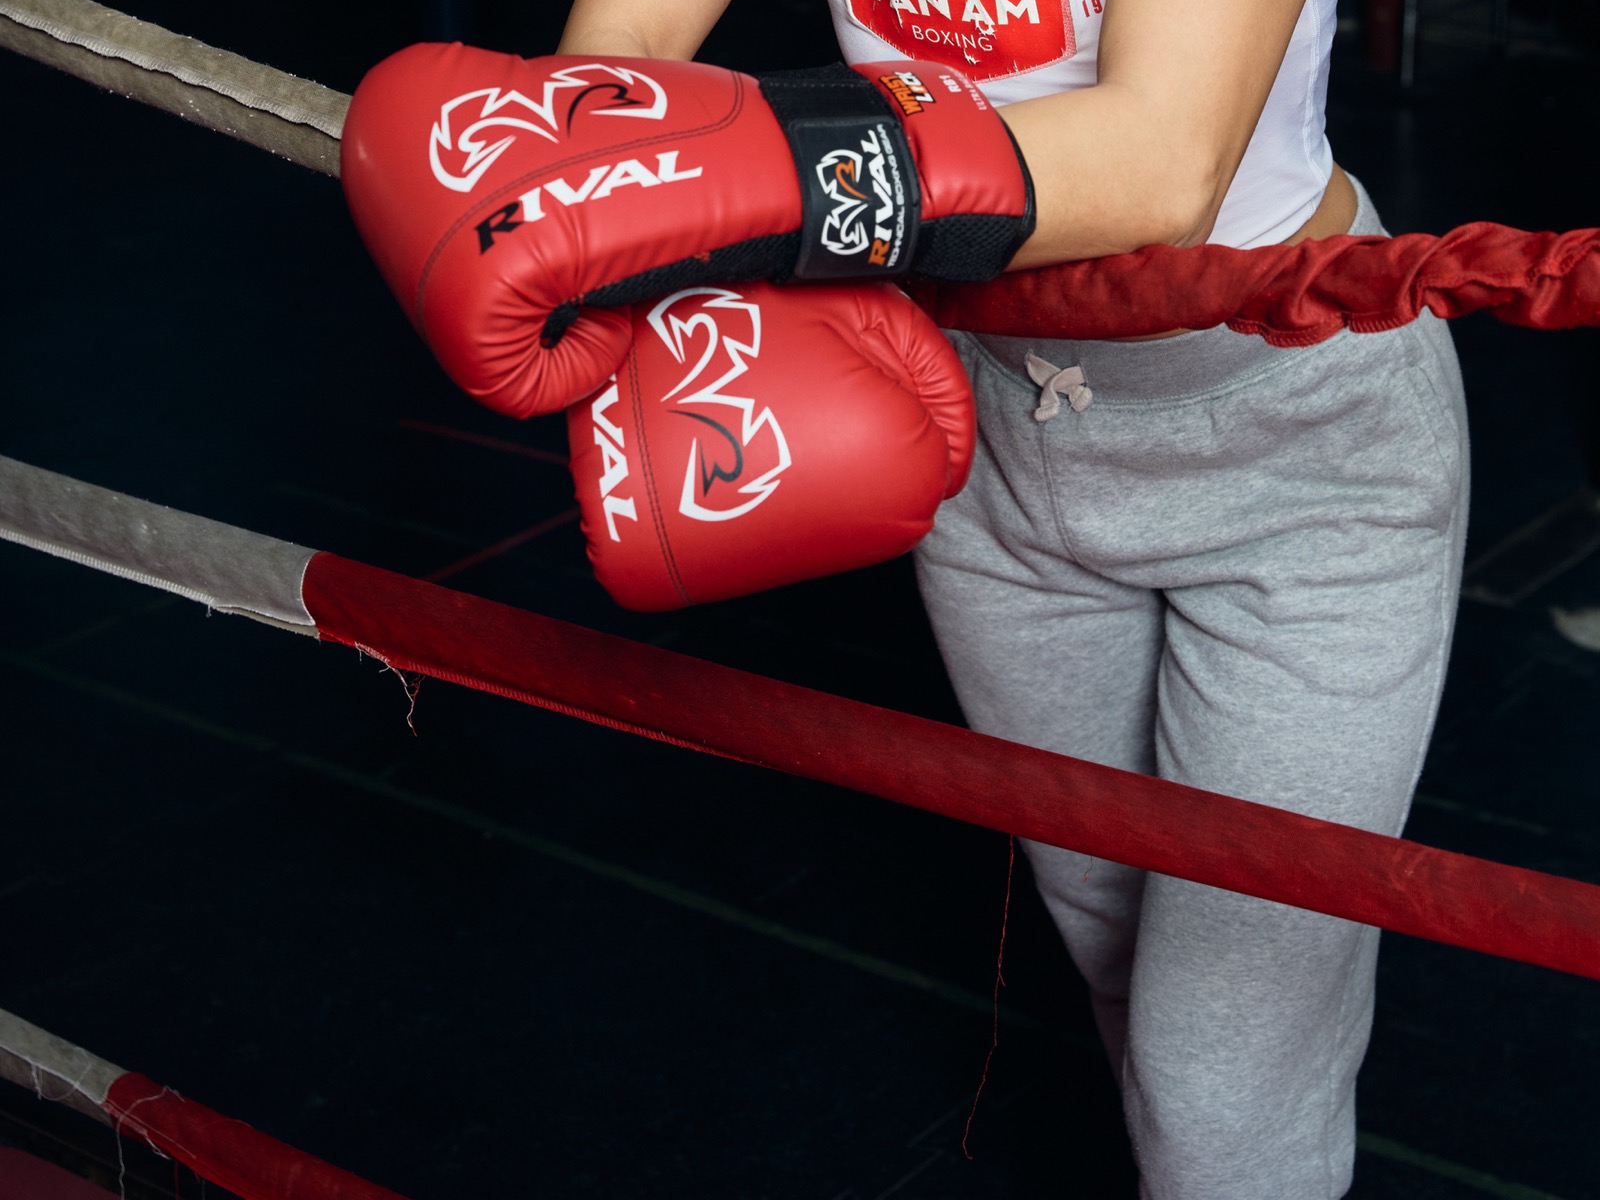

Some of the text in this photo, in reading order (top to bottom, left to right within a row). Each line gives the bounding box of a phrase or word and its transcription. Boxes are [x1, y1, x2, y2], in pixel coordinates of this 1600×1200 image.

[879, 74, 923, 115] WRIST
[911, 24, 994, 52] BOXING
[473, 150, 703, 256] RIVAL
[860, 129, 893, 267] RIVAL
[877, 123, 905, 268] TECHNICAL BOXING GEAR
[591, 373, 638, 543] VAL
